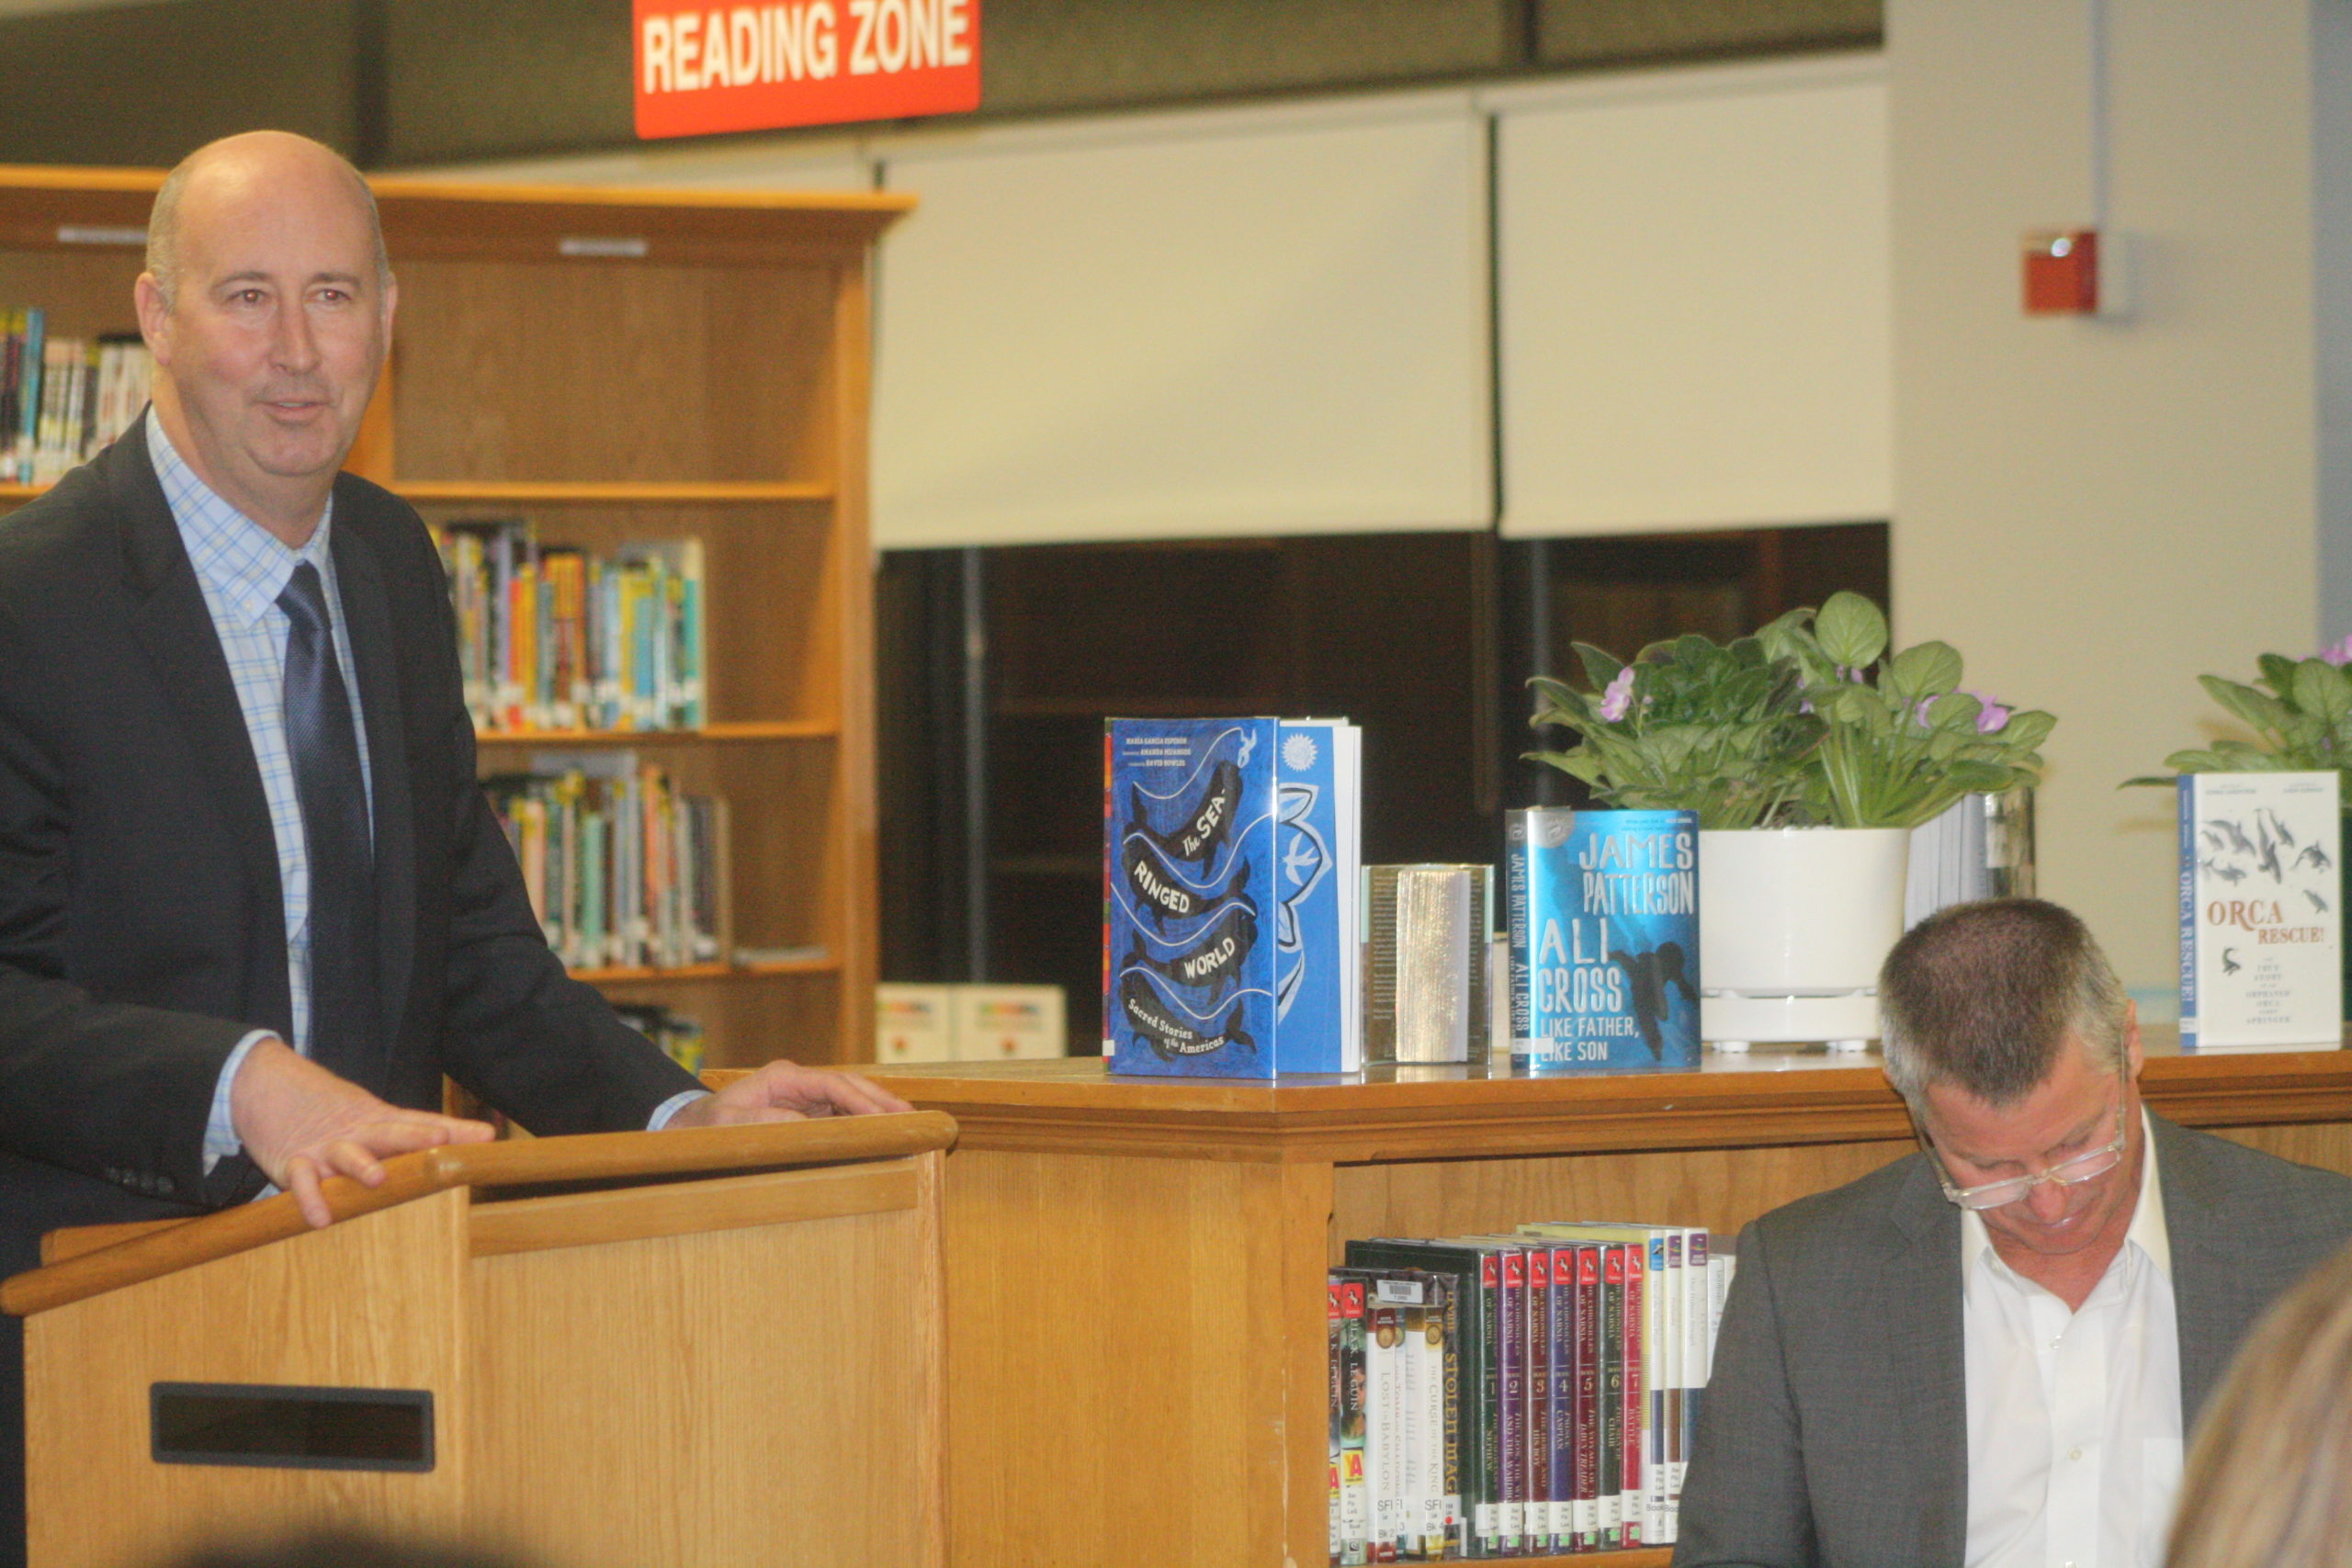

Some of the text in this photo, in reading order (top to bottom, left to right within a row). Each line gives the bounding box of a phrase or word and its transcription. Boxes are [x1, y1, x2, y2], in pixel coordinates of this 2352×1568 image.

[643, 0, 972, 94] READING ZONE
[1182, 835, 1201, 857] The
[1579, 832, 1693, 871] JAMES
[1511, 853, 1525, 890] JAMES
[1134, 860, 1190, 913] RINGED
[1583, 872, 1694, 916] PATTERSON
[1512, 895, 1526, 948] PATTERSON
[2207, 899, 2324, 945] ORCA RESCUE!
[1539, 918, 1609, 964] ALI
[2180, 873, 2194, 1001] ORCA RESCUE!
[1184, 937, 1236, 979] WORLD
[1515, 964, 1529, 987] ALI
[1537, 967, 1622, 1013] CROSS
[1128, 998, 1193, 1039] Sacred Stories
[1515, 994, 1529, 1032] CROSS
[1541, 1017, 1640, 1038] LIKE FATHER,
[1179, 1036, 1225, 1054] Americas
[1577, 1041, 1608, 1061] SON
[1580, 1295, 1586, 1305] OF
[1351, 1363, 1358, 1377] LE
[1611, 1375, 1619, 1388] 6
[1632, 1373, 1639, 1389] 7
[1381, 1372, 1390, 1408] LOST
[1490, 1382, 1496, 1394] 1
[1510, 1381, 1518, 1393] 2
[1536, 1380, 1544, 1393] 3
[1559, 1380, 1568, 1392] 4
[1584, 1379, 1593, 1392] 5
[1430, 1385, 1438, 1426] CURSE
[1381, 1422, 1390, 1491] BABYLON
[1329, 1467, 1340, 1489] A
[1430, 1463, 1438, 1492] KING
[1378, 1529, 1395, 1538] Bk 2
